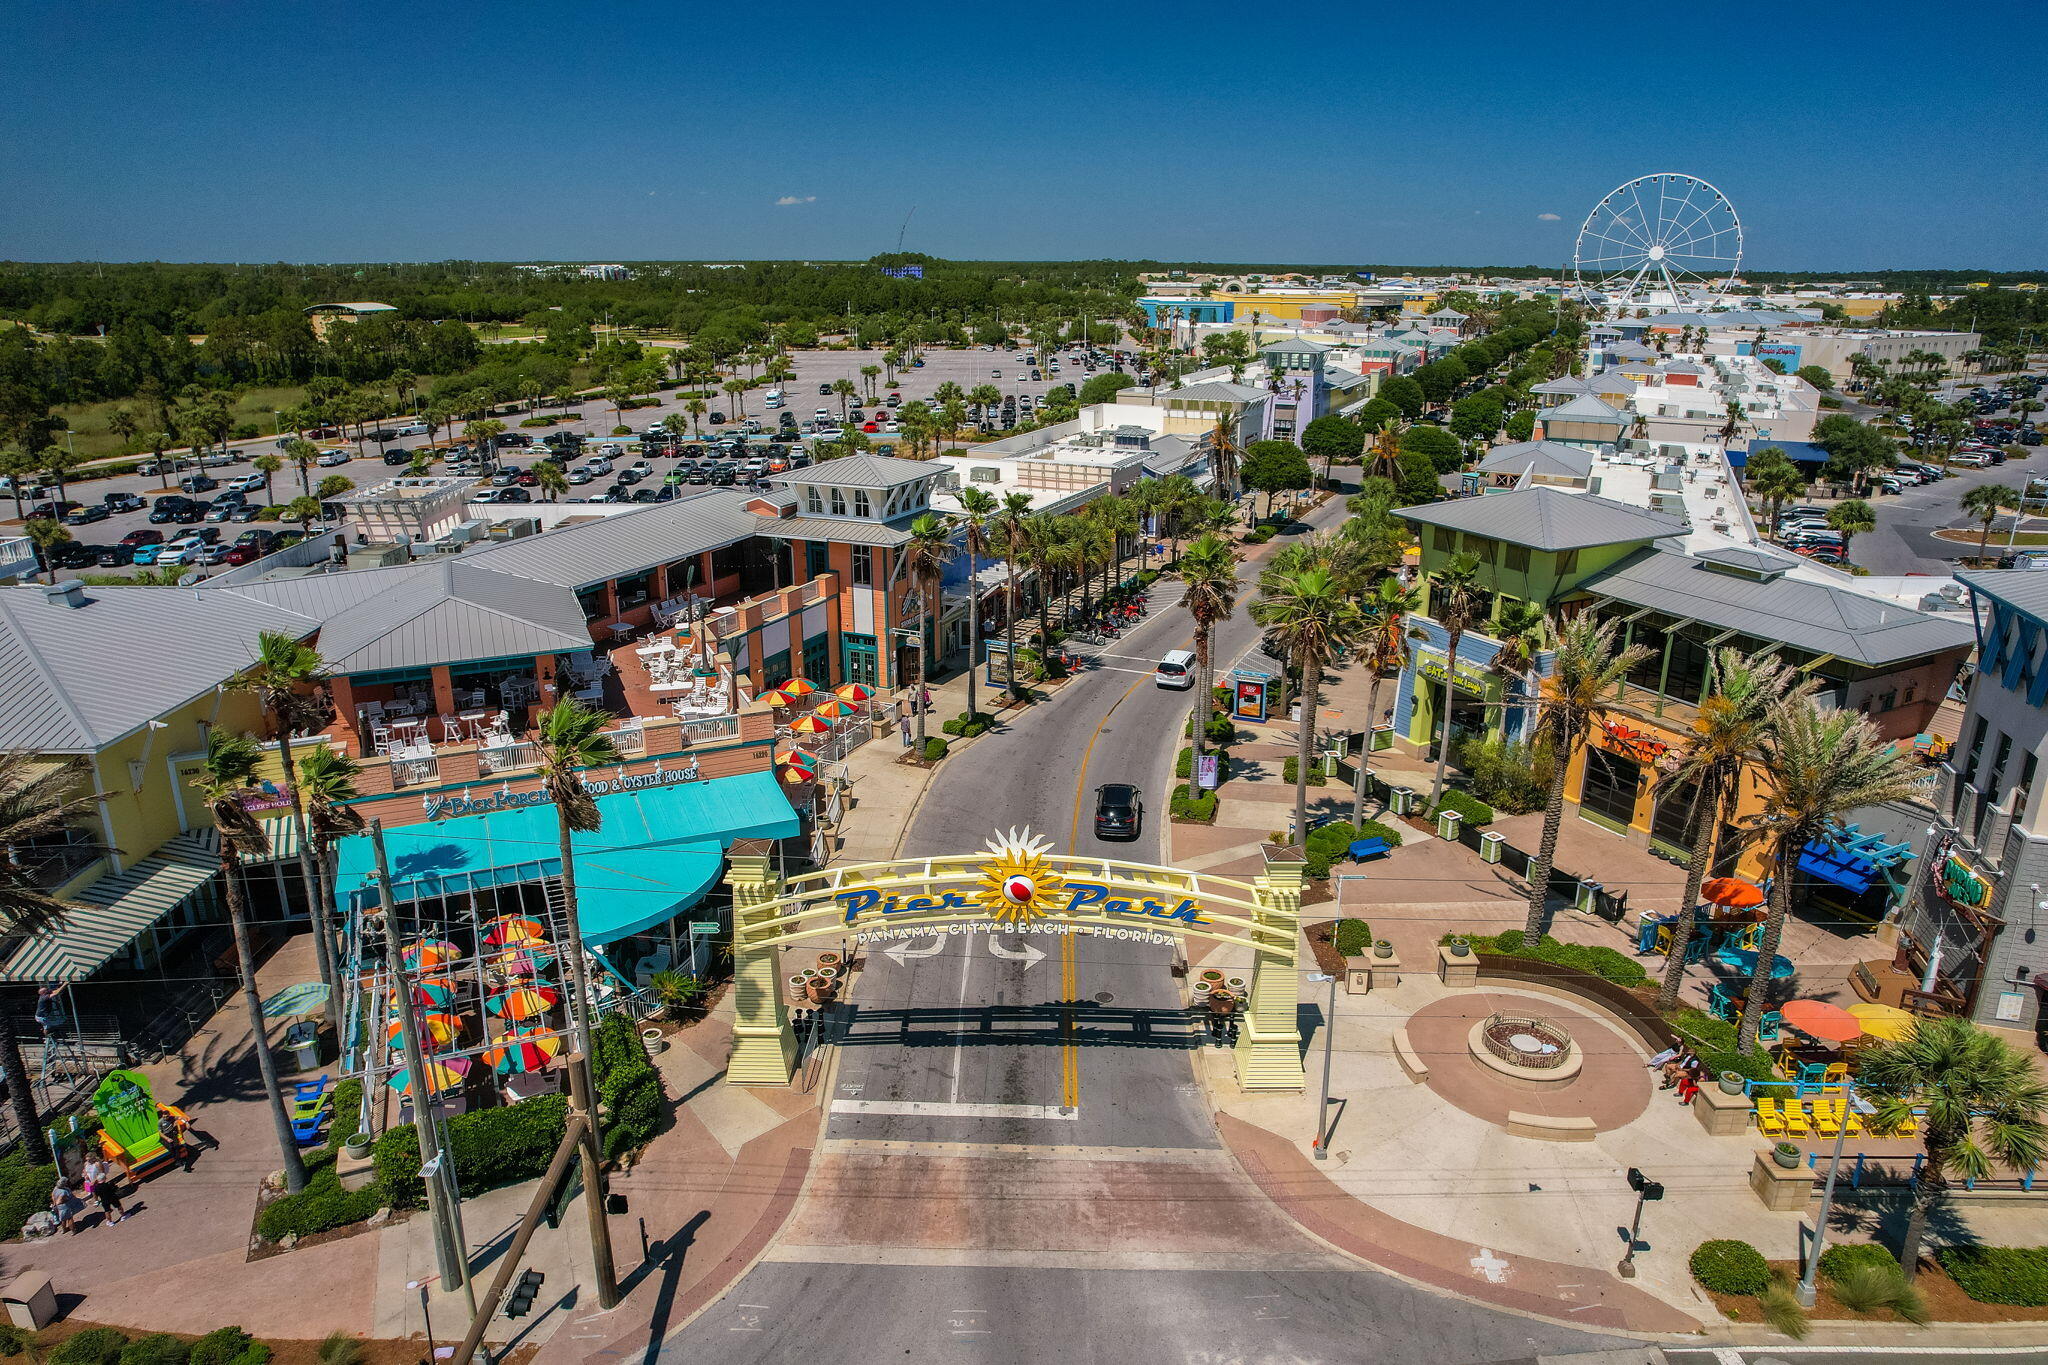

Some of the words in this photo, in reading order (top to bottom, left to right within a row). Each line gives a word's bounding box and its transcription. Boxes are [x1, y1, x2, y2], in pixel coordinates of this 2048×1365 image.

[1426, 665, 1443, 678] EAT
[623, 773, 662, 789] OYSTER
[665, 767, 697, 783] HOUSE
[834, 888, 982, 921] Pier
[1062, 881, 1213, 925] Park
[857, 924, 939, 944] PANAMA
[948, 922, 994, 935] CITY
[1004, 922, 1069, 935] BEACH
[1093, 926, 1176, 946] FLORIDA
